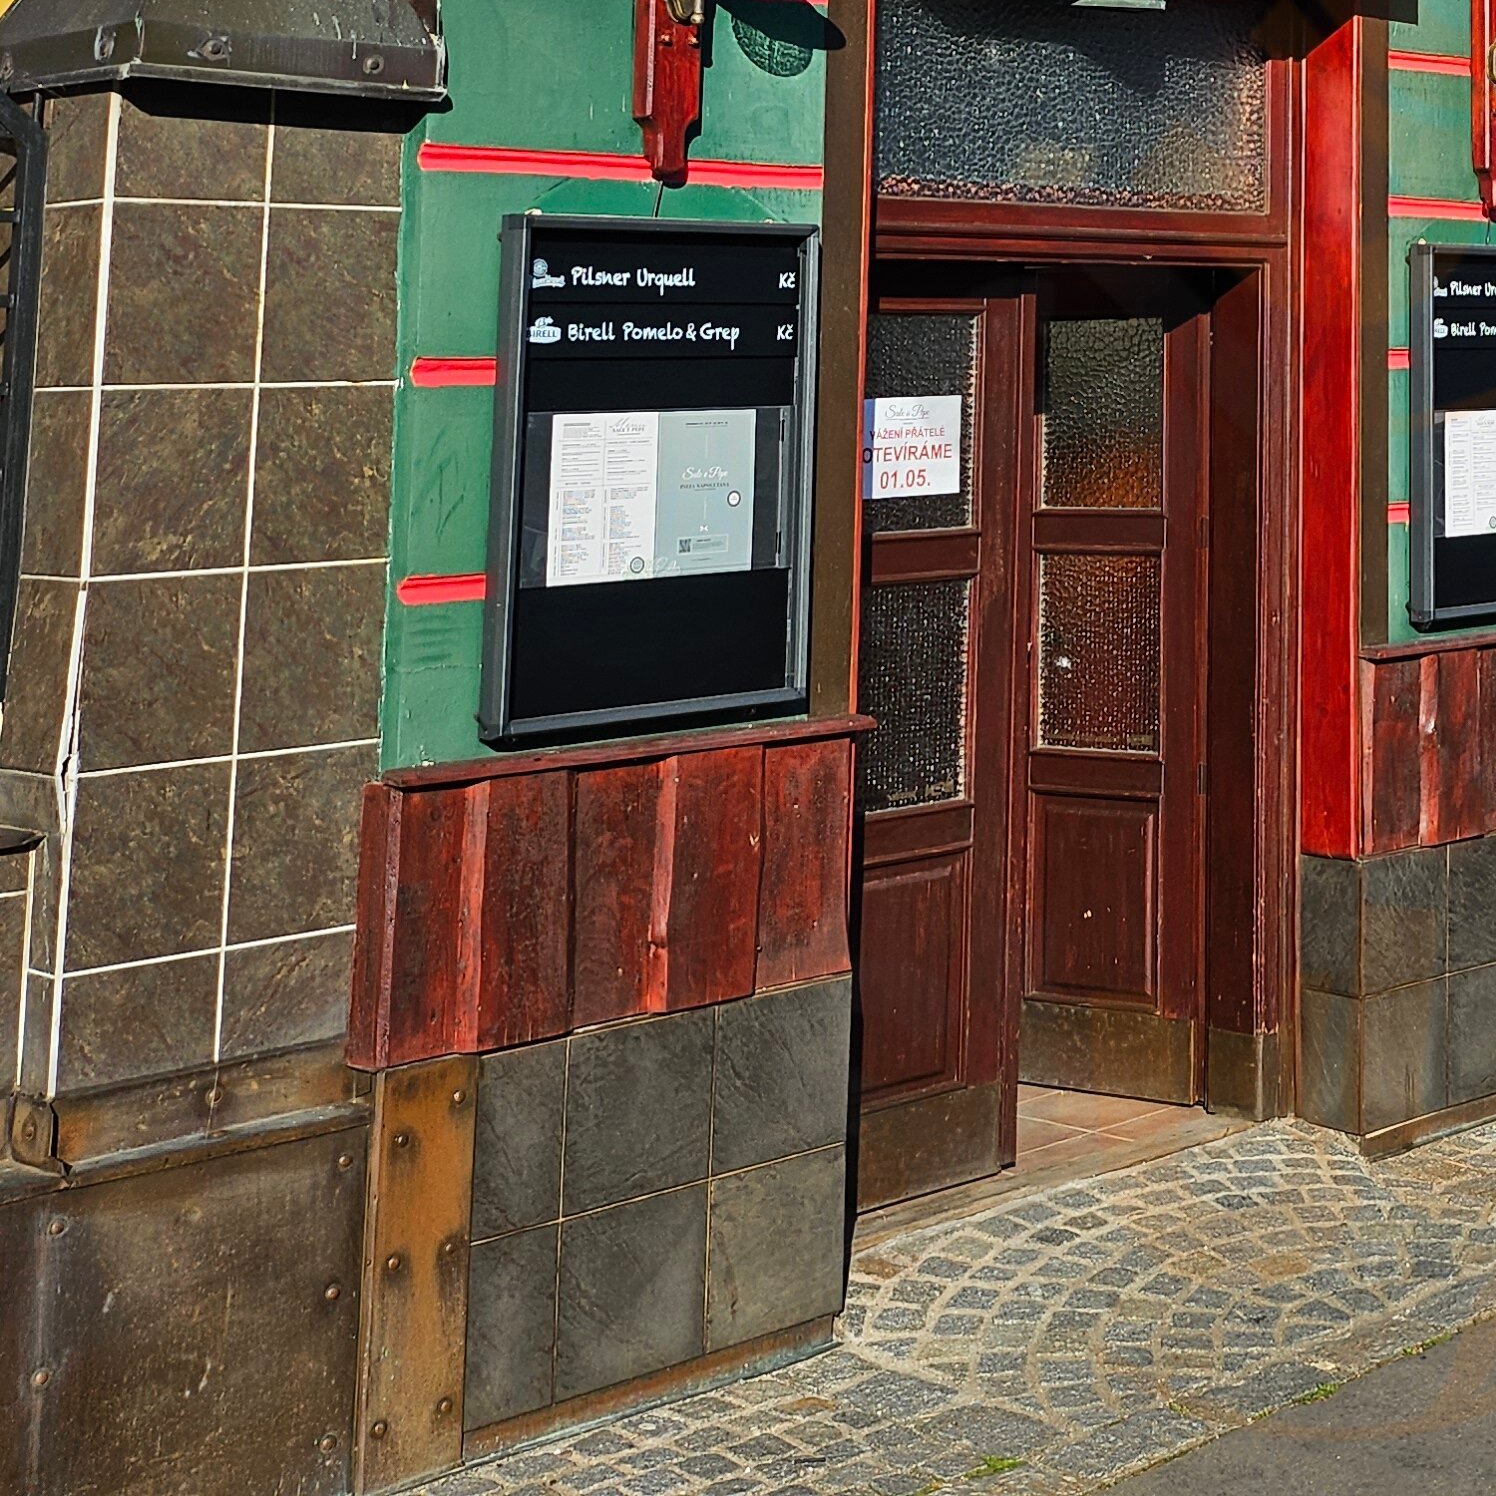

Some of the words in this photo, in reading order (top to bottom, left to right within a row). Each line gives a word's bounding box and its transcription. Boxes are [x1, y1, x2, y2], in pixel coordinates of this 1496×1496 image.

[571, 266, 631, 286] Pilsner
[636, 267, 696, 297] Urquell
[778, 271, 796, 289] Kč
[1449, 280, 1483, 297] Pilsner
[568, 321, 616, 341] Birell
[622, 321, 684, 341] Pomelo
[685, 322, 697, 342] &
[699, 321, 740, 351] Grep
[776, 323, 794, 341] Kč
[1451, 321, 1477, 337] Birell
[862, 440, 953, 464] OTEVÍRÁME
[880, 468, 931, 490] 01.05.
